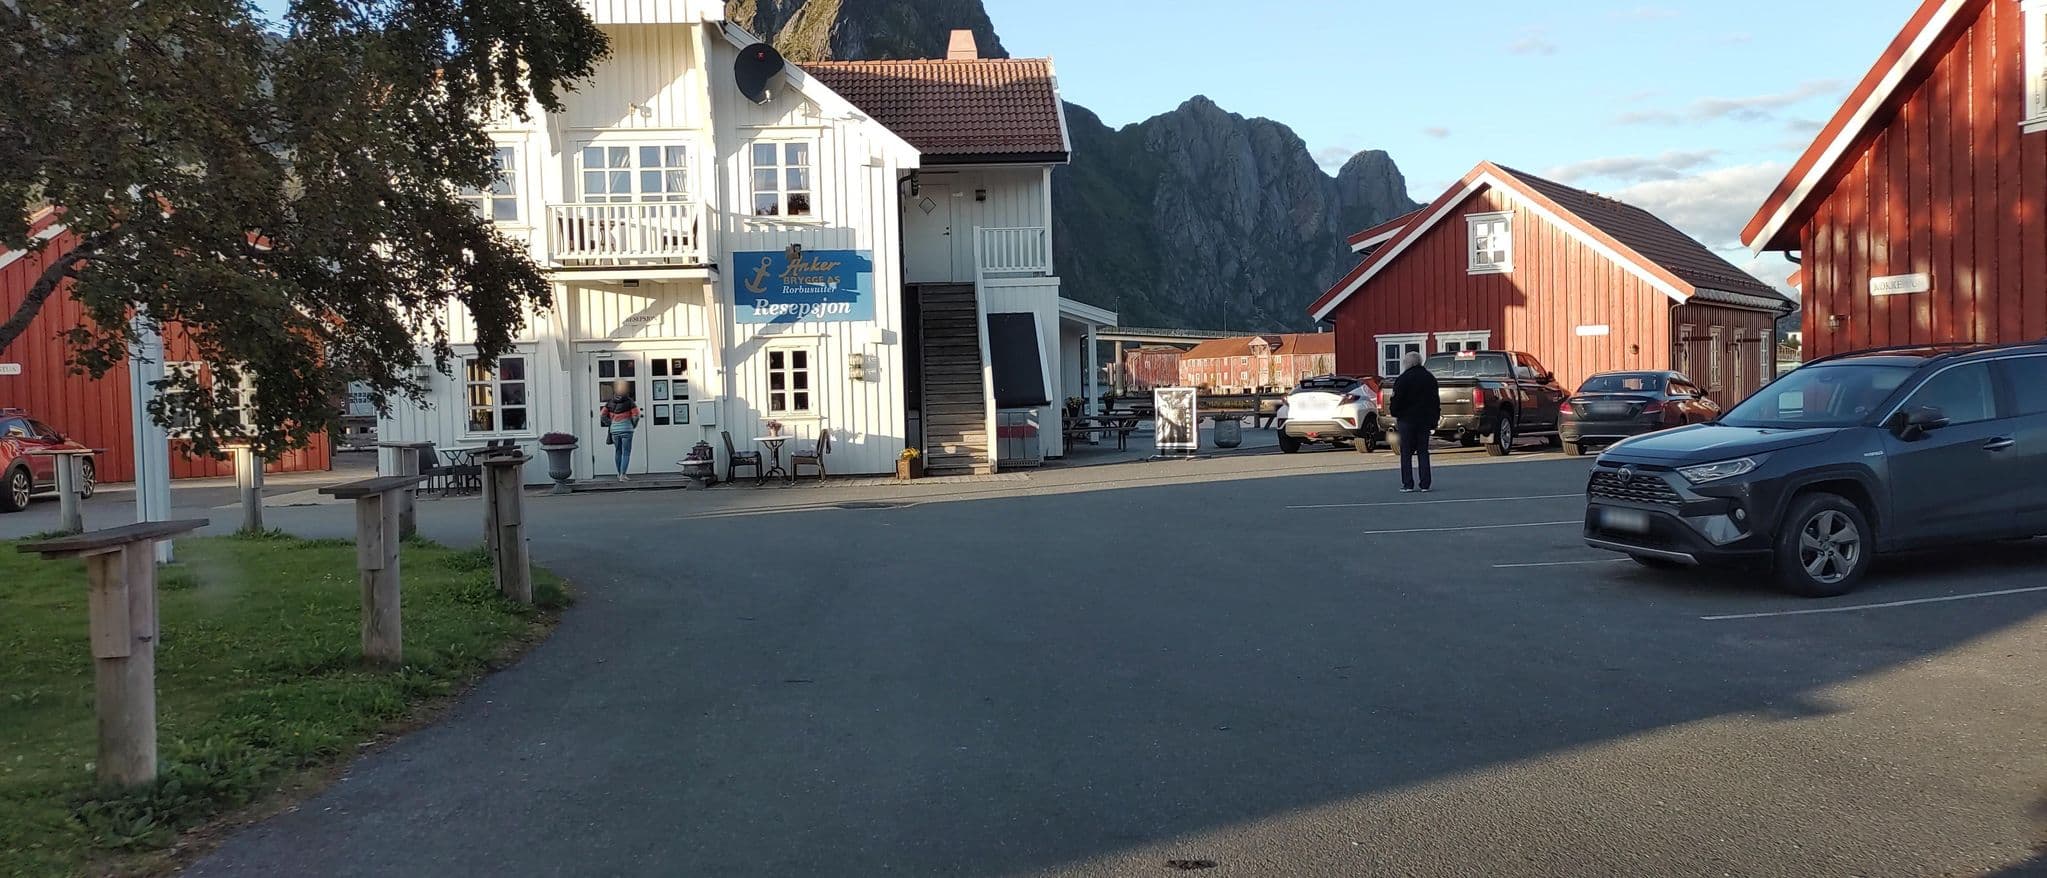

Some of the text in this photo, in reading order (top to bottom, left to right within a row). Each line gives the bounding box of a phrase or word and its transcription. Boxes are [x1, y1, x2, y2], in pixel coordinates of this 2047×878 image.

[779, 257, 840, 278] Anker
[783, 275, 840, 285] BRYGGE AS
[753, 297, 851, 319] Resepsjon
